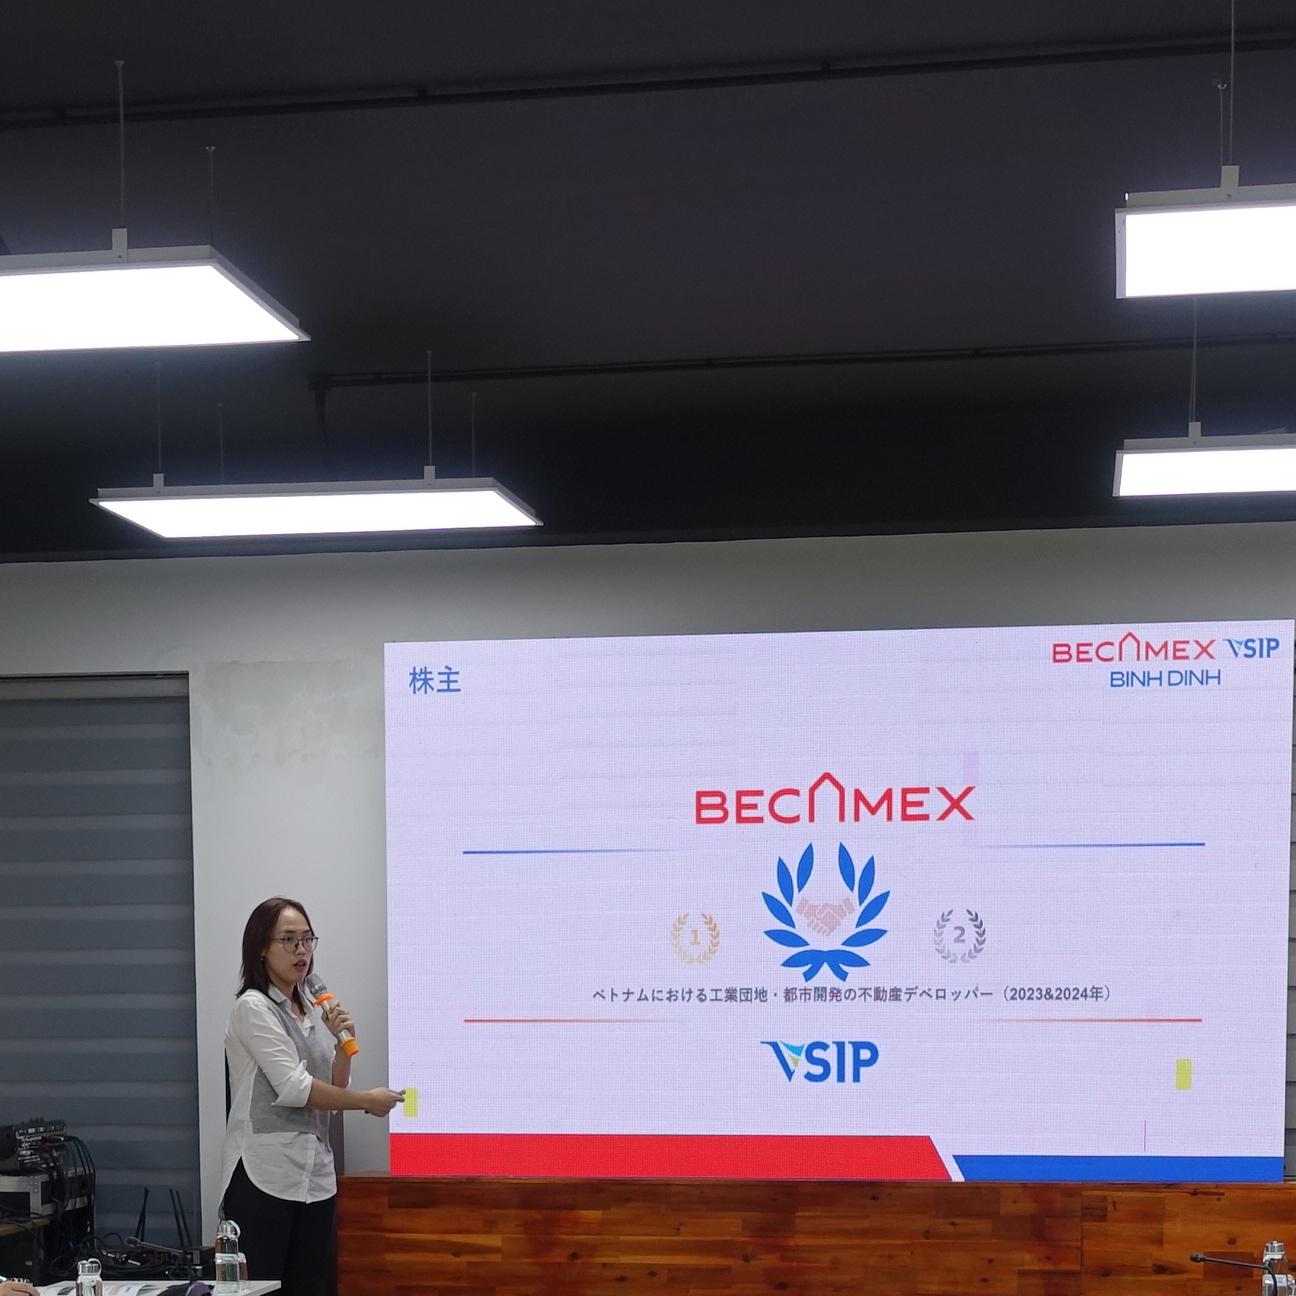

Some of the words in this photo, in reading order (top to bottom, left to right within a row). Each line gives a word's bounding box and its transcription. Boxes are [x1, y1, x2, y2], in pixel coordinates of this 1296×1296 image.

[1224, 637, 1280, 659] VSIP
[409, 665, 461, 695] 株主
[1110, 670, 1163, 688] BINH
[1167, 669, 1221, 687] DINH
[689, 929, 701, 945] 1
[953, 926, 966, 944] 2
[760, 1040, 879, 1083] VSIP
